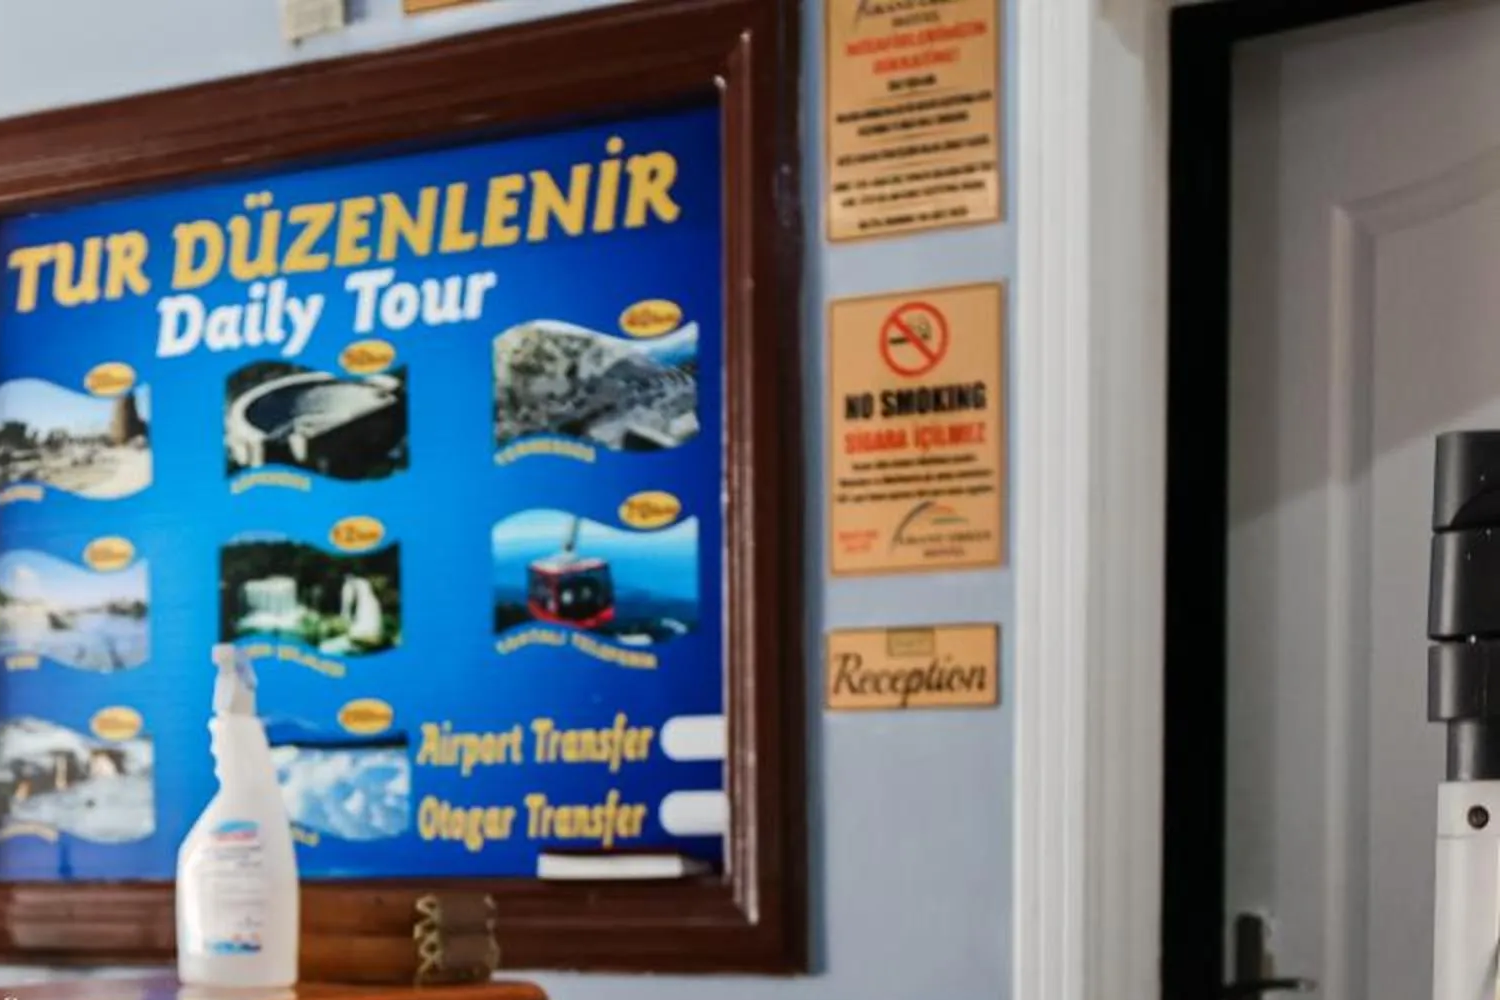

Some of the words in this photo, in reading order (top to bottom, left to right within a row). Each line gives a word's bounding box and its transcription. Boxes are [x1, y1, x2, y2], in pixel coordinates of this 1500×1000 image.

[8, 231, 151, 313] TUR
[171, 136, 681, 290] DÜZENLENİR
[157, 280, 324, 358] Daily
[344, 268, 497, 333] Tour
[845, 394, 875, 420] NO
[880, 382, 988, 418] SMOKING
[833, 653, 987, 708] Reception
[416, 720, 524, 777] Airport
[531, 712, 654, 773] Transfer
[417, 794, 517, 852] Otogar
[524, 788, 647, 848] Transfer
